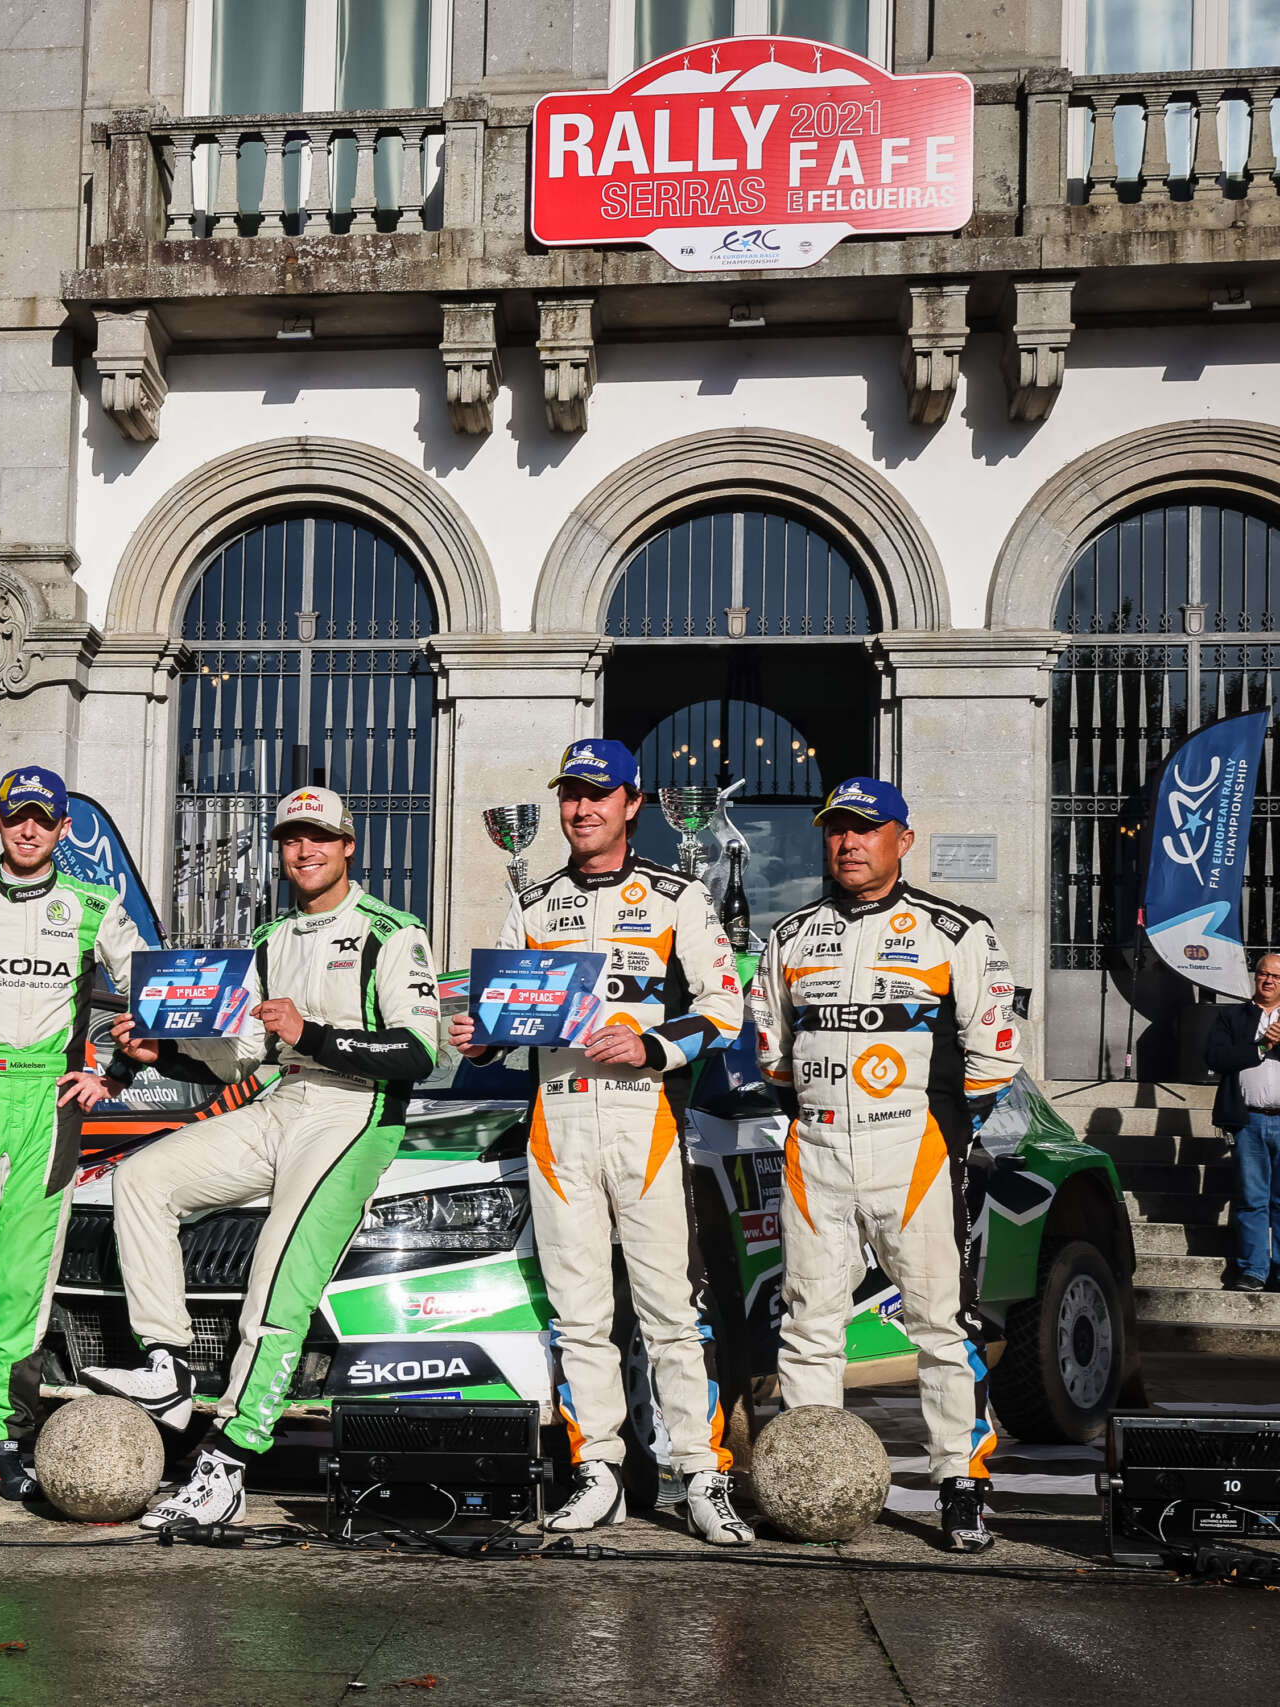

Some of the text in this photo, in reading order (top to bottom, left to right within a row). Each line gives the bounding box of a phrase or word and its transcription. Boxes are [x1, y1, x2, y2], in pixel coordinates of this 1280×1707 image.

[549, 99, 881, 178] RALLY 2021
[788, 136, 955, 188] FAFE
[601, 177, 766, 220] SERRAS
[787, 184, 955, 213] E FELGUEIRAS
[10, 784, 53, 798] MICHELIN
[287, 803, 324, 815] Red Bull
[1224, 758, 1248, 867] CHAMPIONSHIP
[1209, 757, 1236, 889] FIA EUROPEAN RALLY
[15, 888, 47, 899] ŠKODA
[656, 881, 679, 893] OMP
[85, 898, 106, 912] OMP
[618, 908, 648, 920] galp
[374, 919, 393, 935] OMP
[938, 918, 961, 933] OMP
[40, 928, 74, 939] ŠKODA
[885, 937, 916, 949] galp
[184, 988, 207, 997] PLACE
[991, 984, 1014, 994] BELL
[530, 992, 553, 1002] PLACE
[819, 1006, 884, 1031] MEO
[9, 1060, 47, 1070] Mikkelsen
[802, 1056, 847, 1085] galp
[546, 1083, 564, 1093] OMP
[604, 1079, 614, 1091] A.
[122, 1085, 178, 1103] Arnautov
[857, 1108, 912, 1124] L. RAMALHO
[734, 1156, 750, 1210] 1
[347, 1356, 472, 1385] ŠKODA
[1223, 1480, 1241, 1492] 10
[192, 1487, 214, 1508] one
